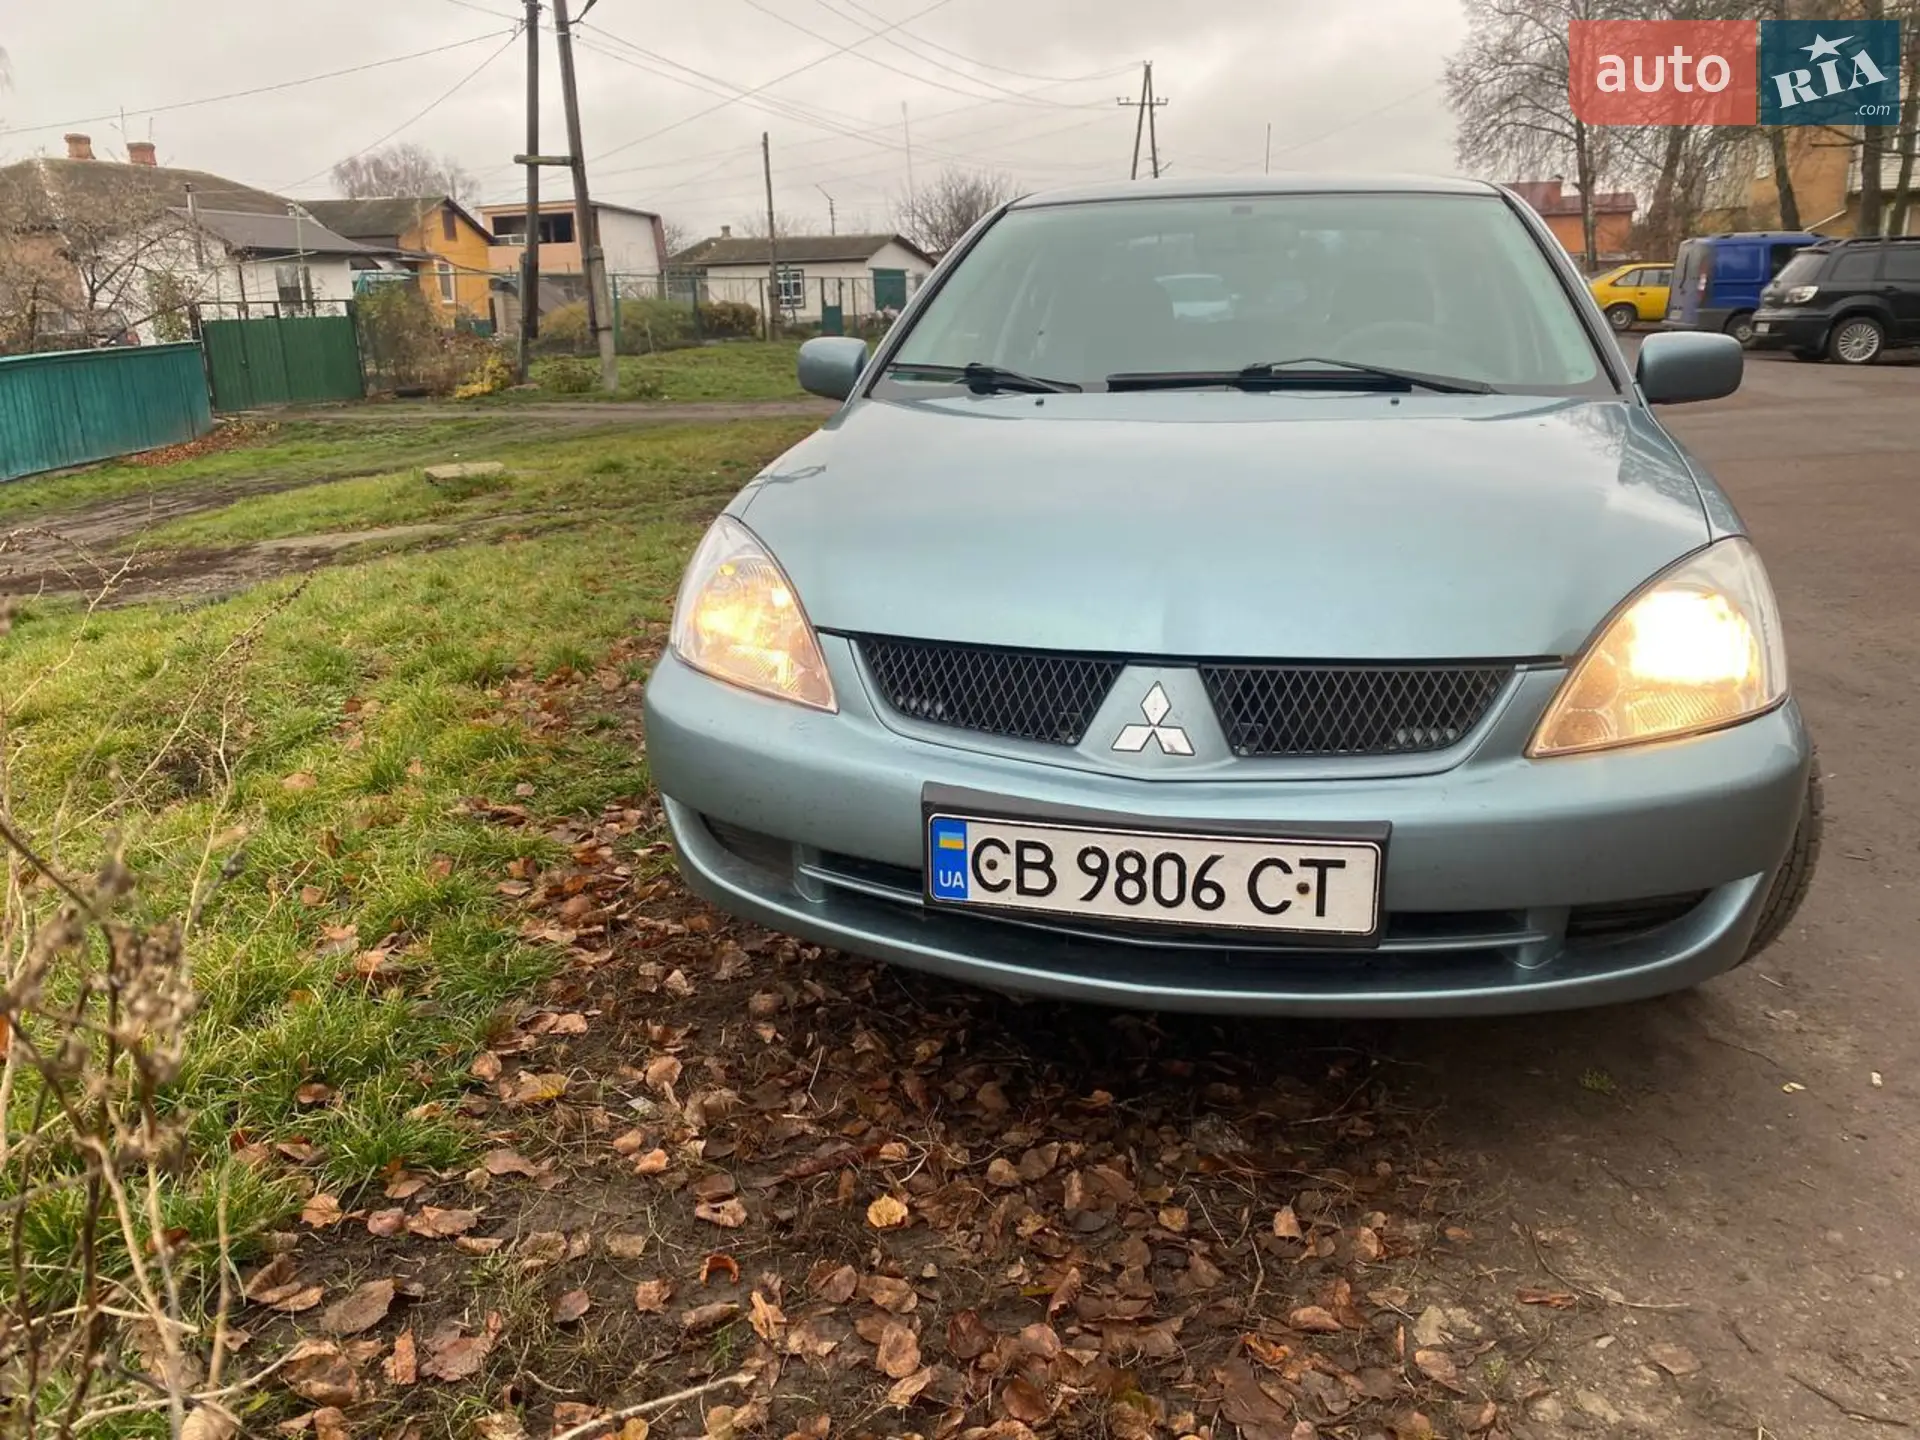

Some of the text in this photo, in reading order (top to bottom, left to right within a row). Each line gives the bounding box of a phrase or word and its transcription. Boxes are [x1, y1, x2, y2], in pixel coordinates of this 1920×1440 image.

[938, 870, 965, 889] UA
[971, 837, 1346, 918] CB 9806 CT
